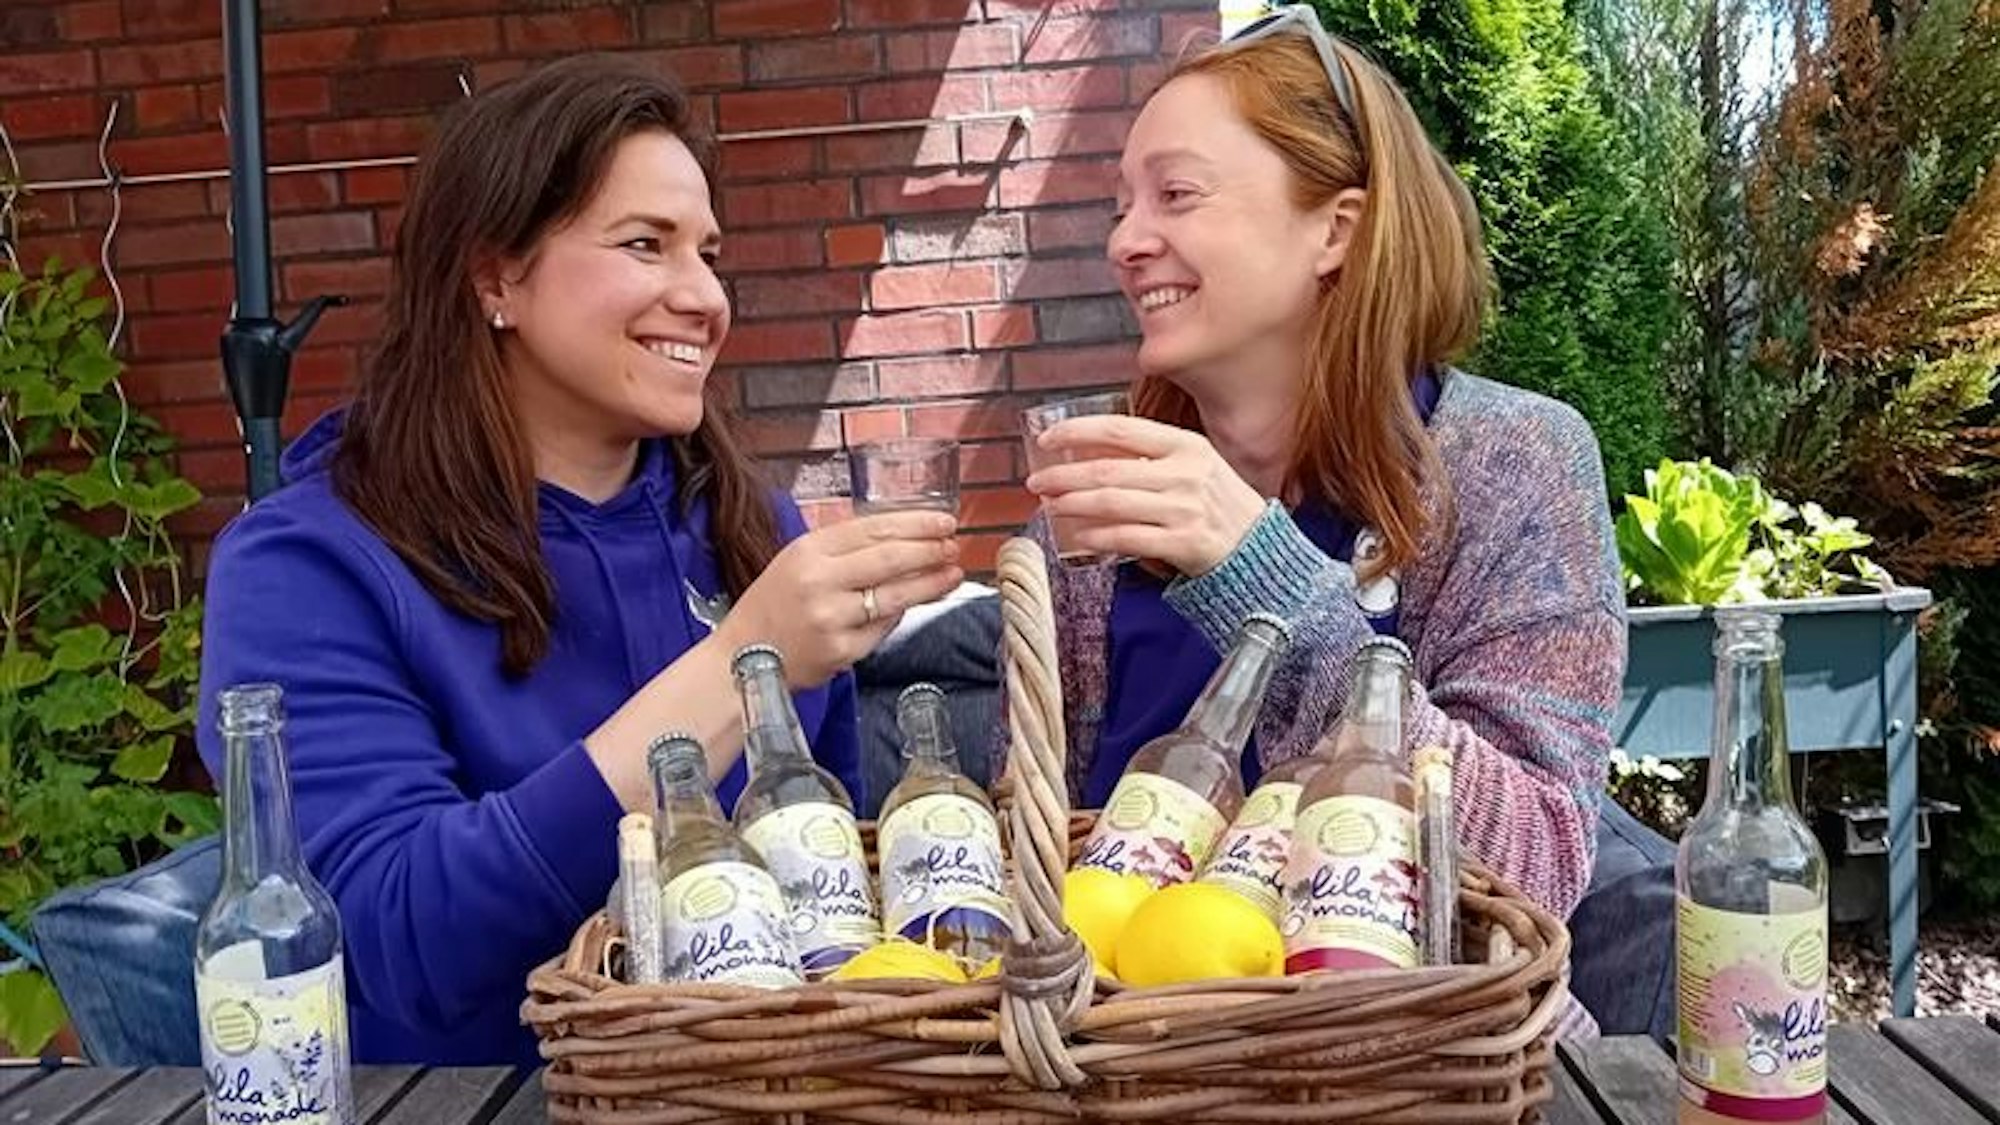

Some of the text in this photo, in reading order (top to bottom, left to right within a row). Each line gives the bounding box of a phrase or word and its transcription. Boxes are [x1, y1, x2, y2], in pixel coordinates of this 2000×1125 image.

[927, 845, 983, 876] lila
[812, 865, 867, 904] lila
[1311, 864, 1374, 904] lila
[690, 922, 753, 966] lila
[214, 1062, 267, 1107] lila
[218, 1091, 328, 1124] monade
